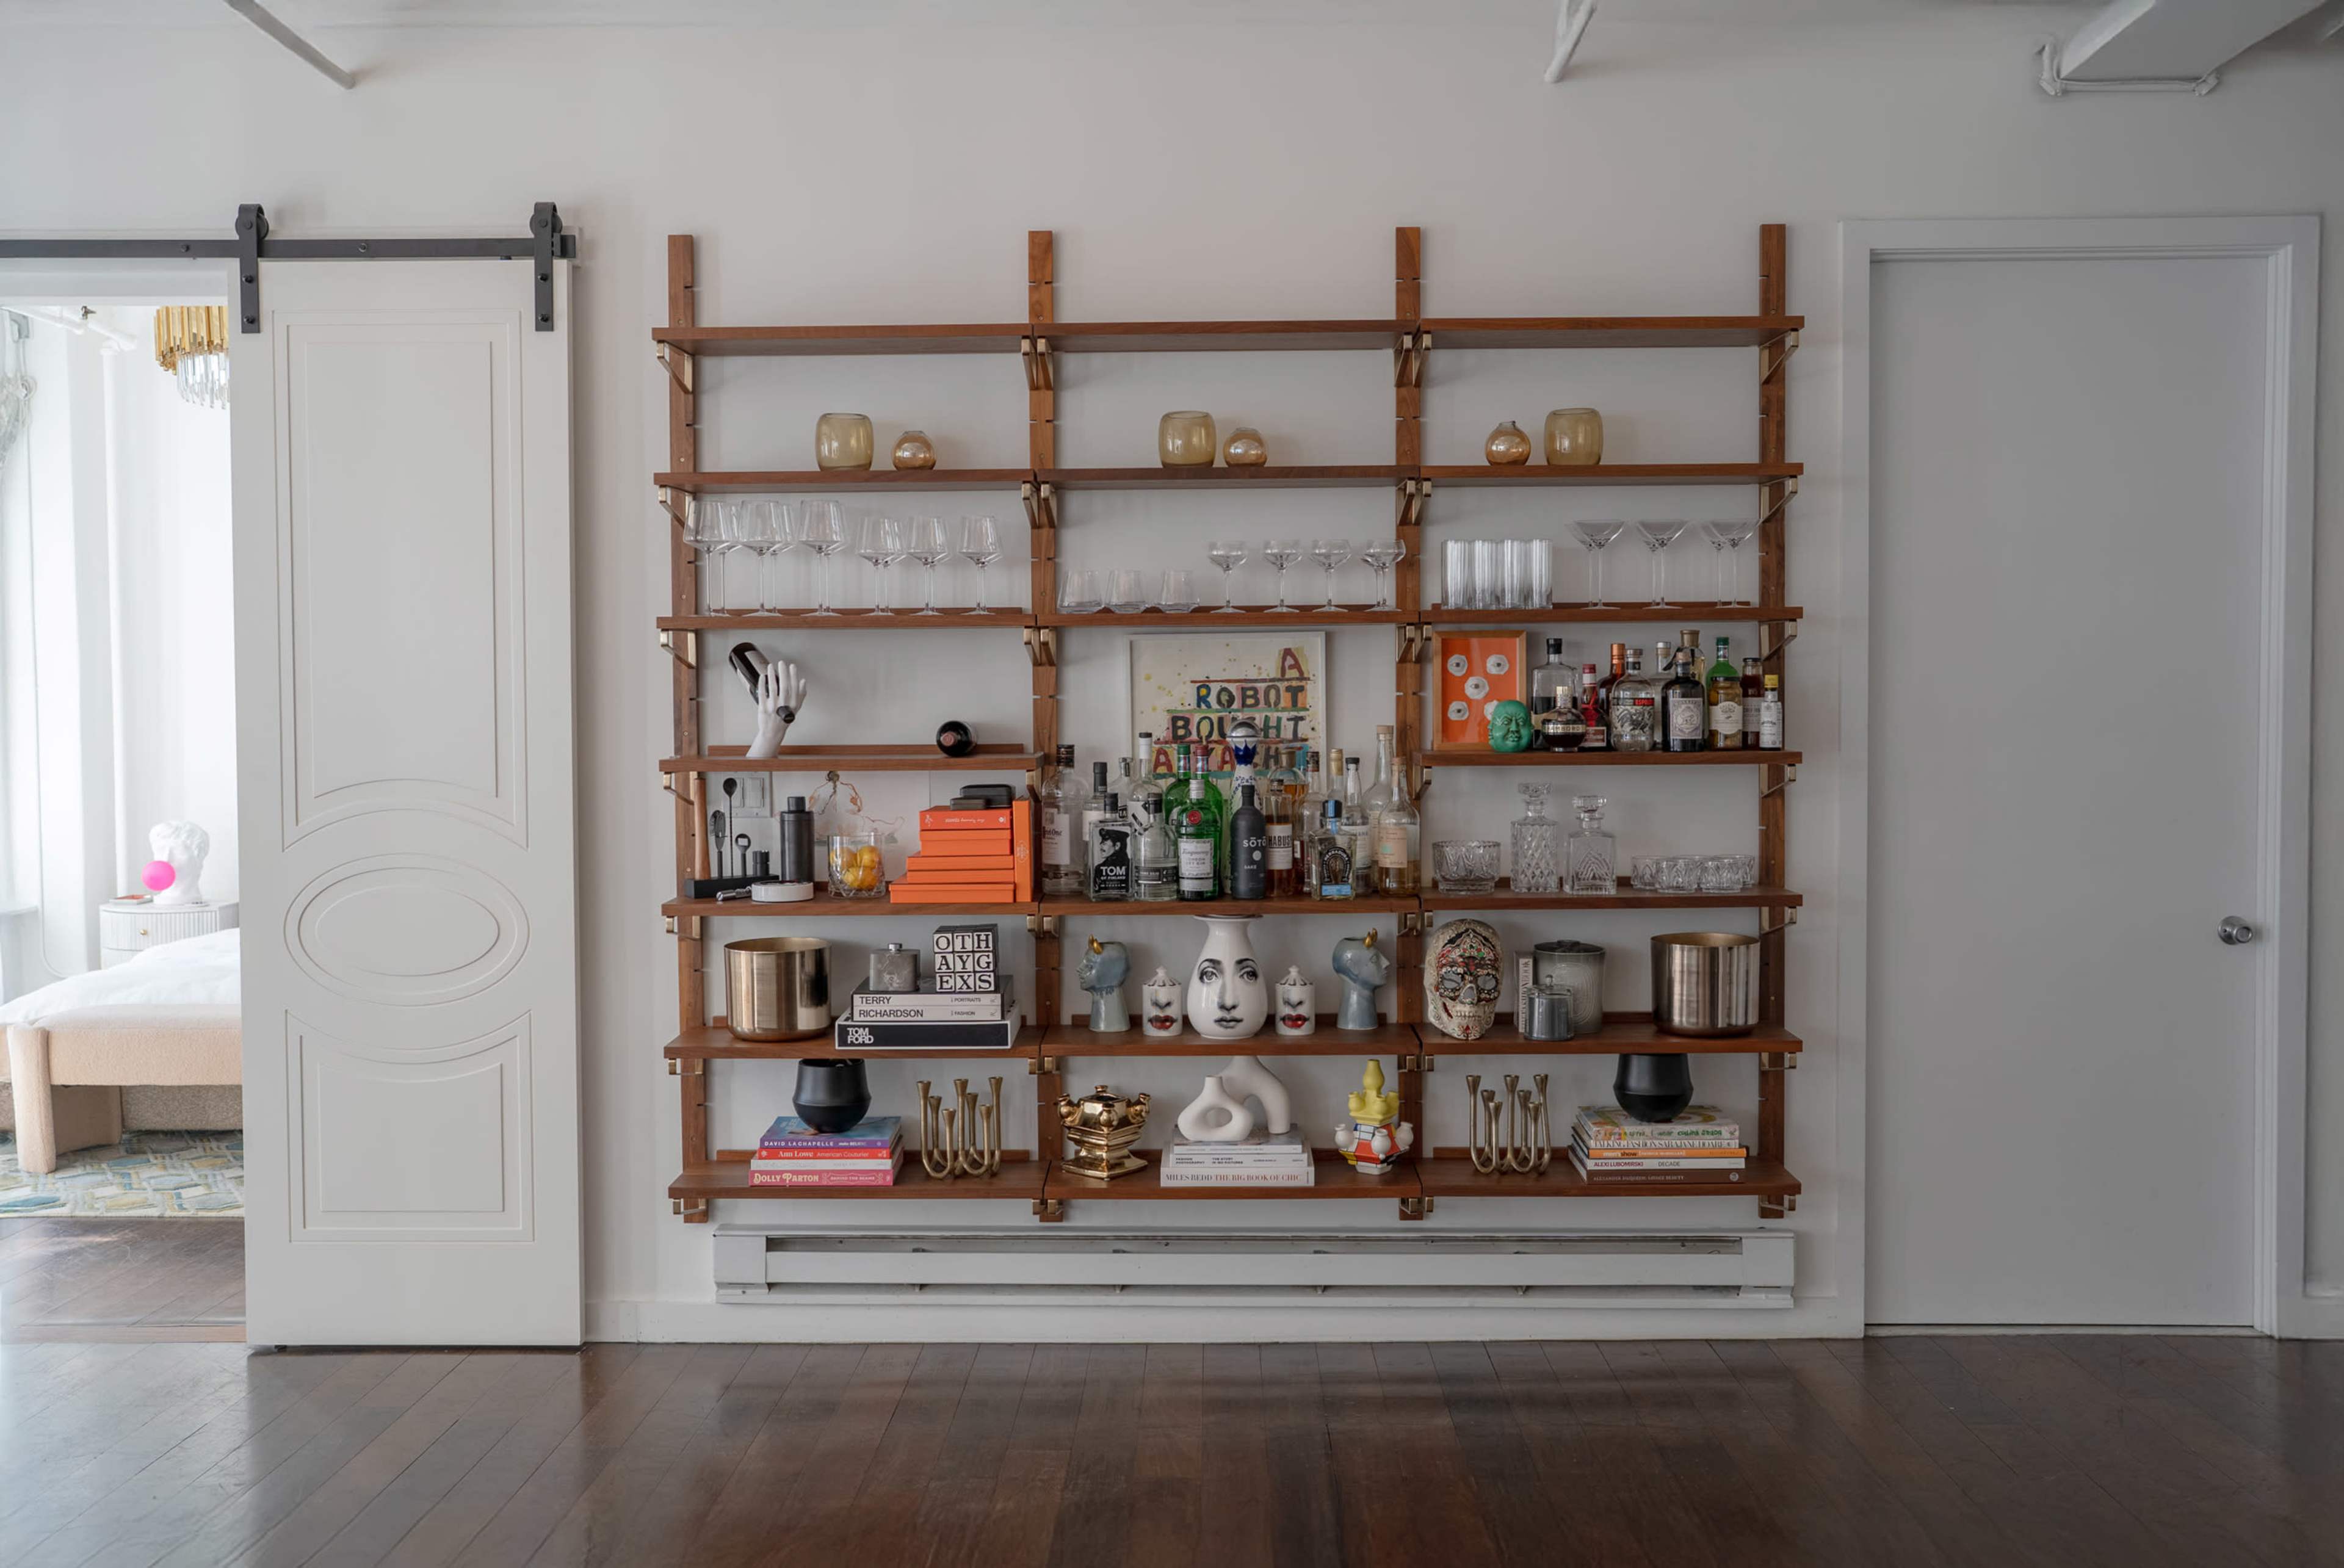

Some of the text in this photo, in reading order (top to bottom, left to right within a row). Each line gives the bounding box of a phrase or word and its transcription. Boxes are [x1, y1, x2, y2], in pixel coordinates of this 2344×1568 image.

[1281, 648, 1305, 677] A
[1196, 683, 1305, 709] ROBOT
[1171, 715, 1306, 742] BOUHT
[1152, 747, 1173, 773] A
[1100, 866, 1127, 876] TOM
[859, 996, 892, 1005] TERRY
[859, 1009, 924, 1018] RICHARDSON
[847, 1027, 869, 1036] TOM
[847, 1035, 874, 1044] FORD
[753, 1172, 781, 1184] DOLLY
[782, 1172, 819, 1183] PARTON
